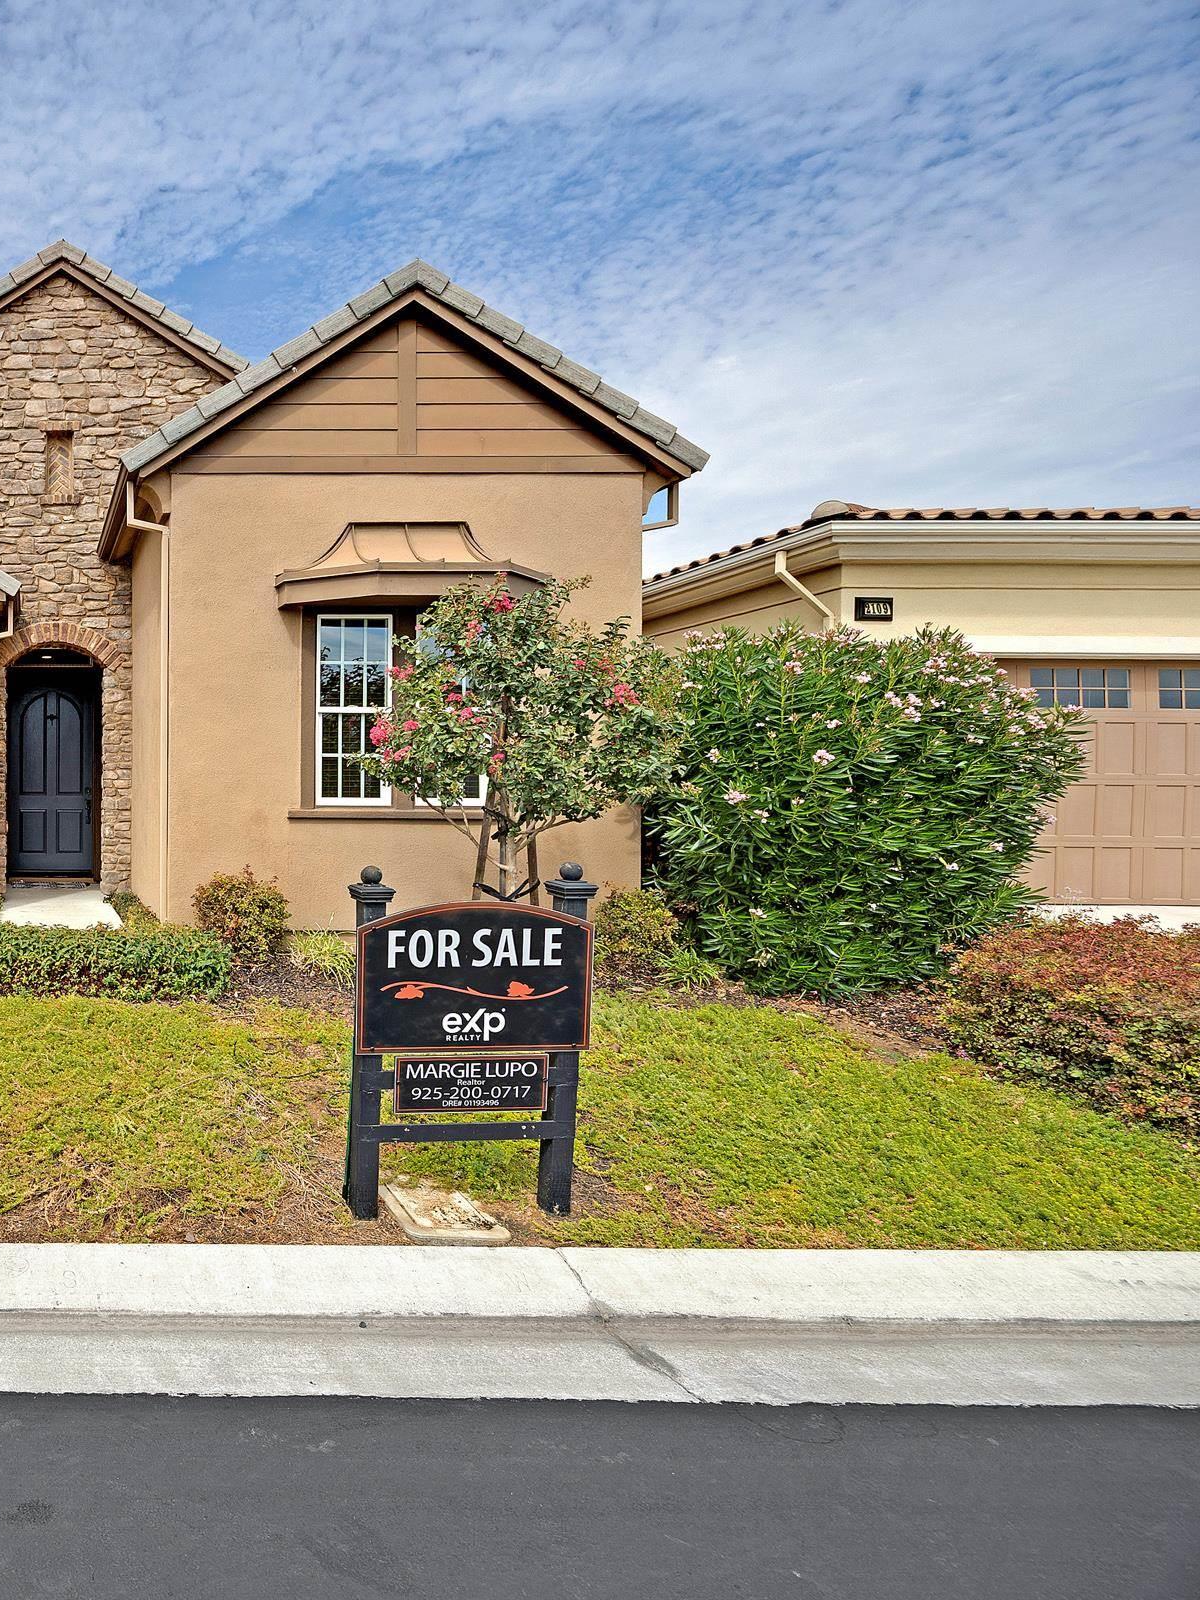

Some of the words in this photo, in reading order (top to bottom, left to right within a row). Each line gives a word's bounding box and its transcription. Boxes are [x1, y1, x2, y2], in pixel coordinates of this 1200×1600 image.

[864, 602, 890, 614] 2109
[388, 930, 460, 968] FOR
[472, 928, 562, 967] SALE
[406, 1063, 481, 1079] MARGIE
[485, 1062, 538, 1077] LUPO
[411, 1086, 531, 1100] 925-200-0717
